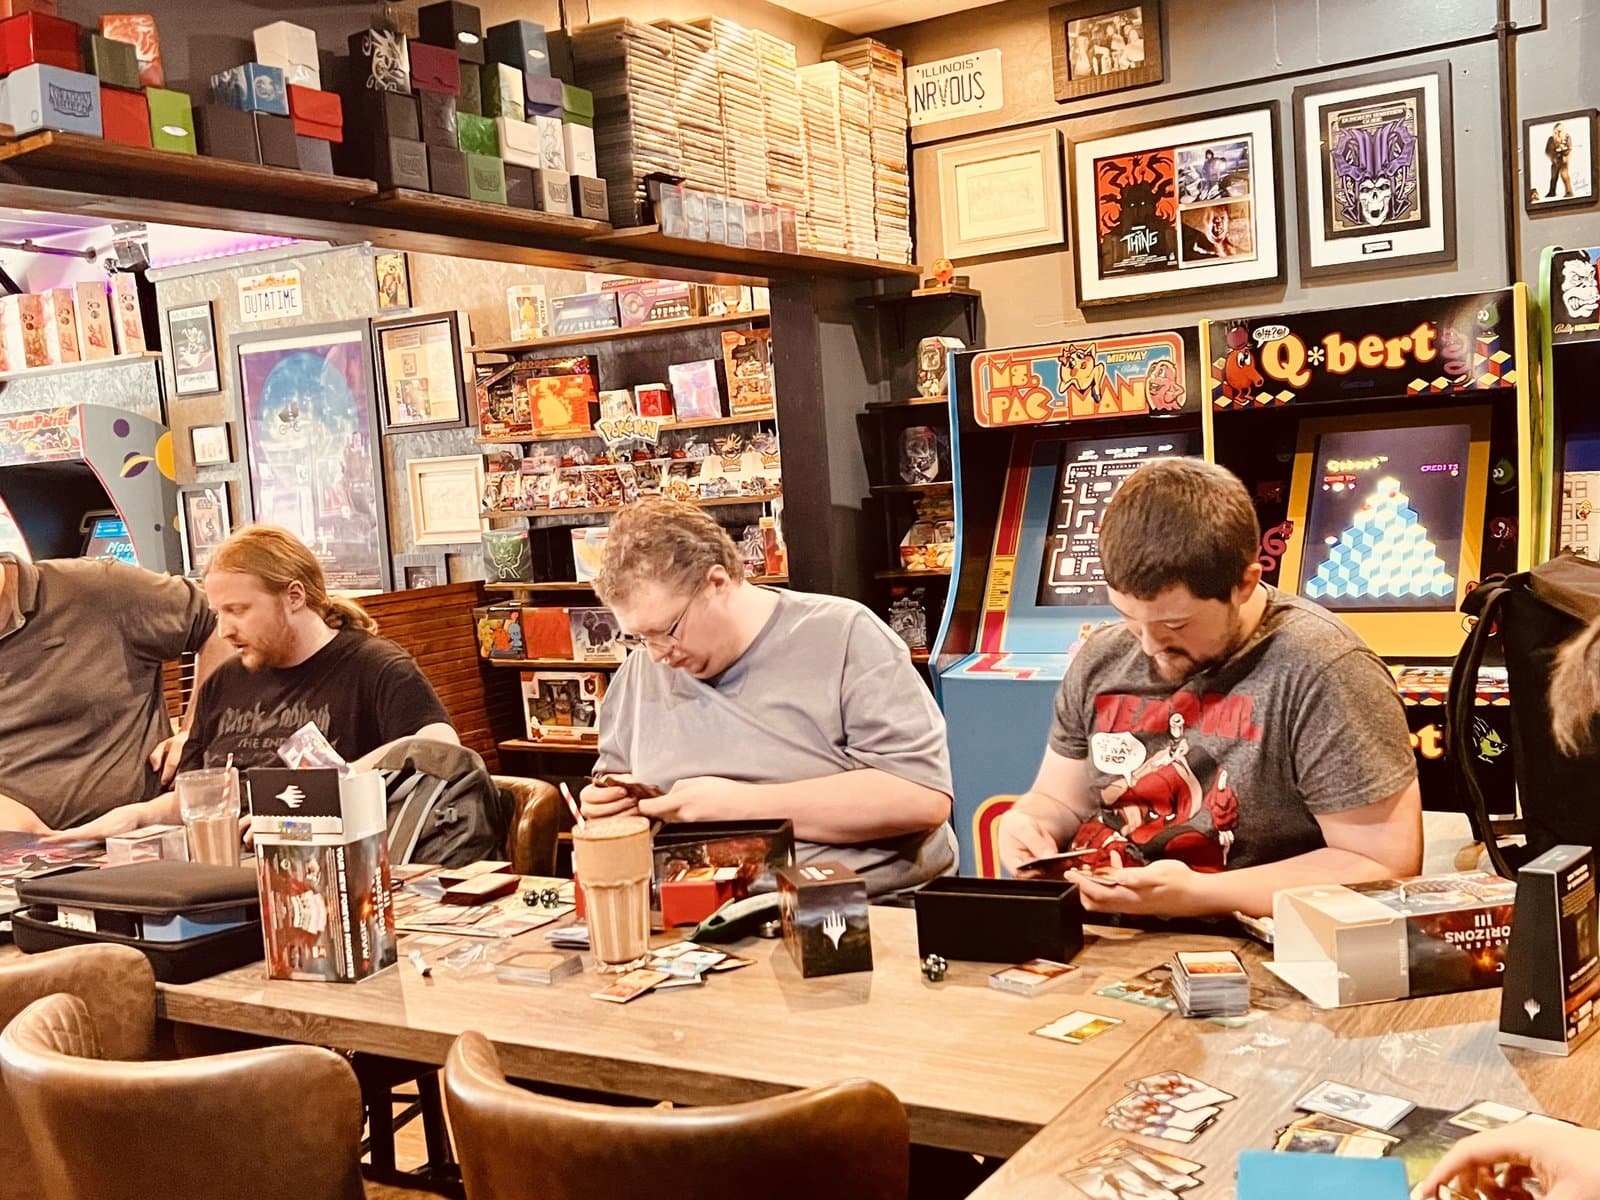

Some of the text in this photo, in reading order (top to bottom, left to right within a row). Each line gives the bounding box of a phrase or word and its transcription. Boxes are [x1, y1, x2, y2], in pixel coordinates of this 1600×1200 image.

[921, 59, 974, 78] ILLINOIS
[913, 71, 985, 113] NRVOUS
[1120, 229, 1159, 254] THING
[244, 288, 297, 314] OUTATIME
[1106, 351, 1147, 364] MIDWAY
[990, 375, 1148, 425] PAC-MAN
[1420, 463, 1459, 472] CREDITS
[238, 738, 259, 748] THE
[1474, 913, 1493, 927] III
[359, 919, 371, 959] MAGIC
[1444, 925, 1512, 943] ORIZONS
